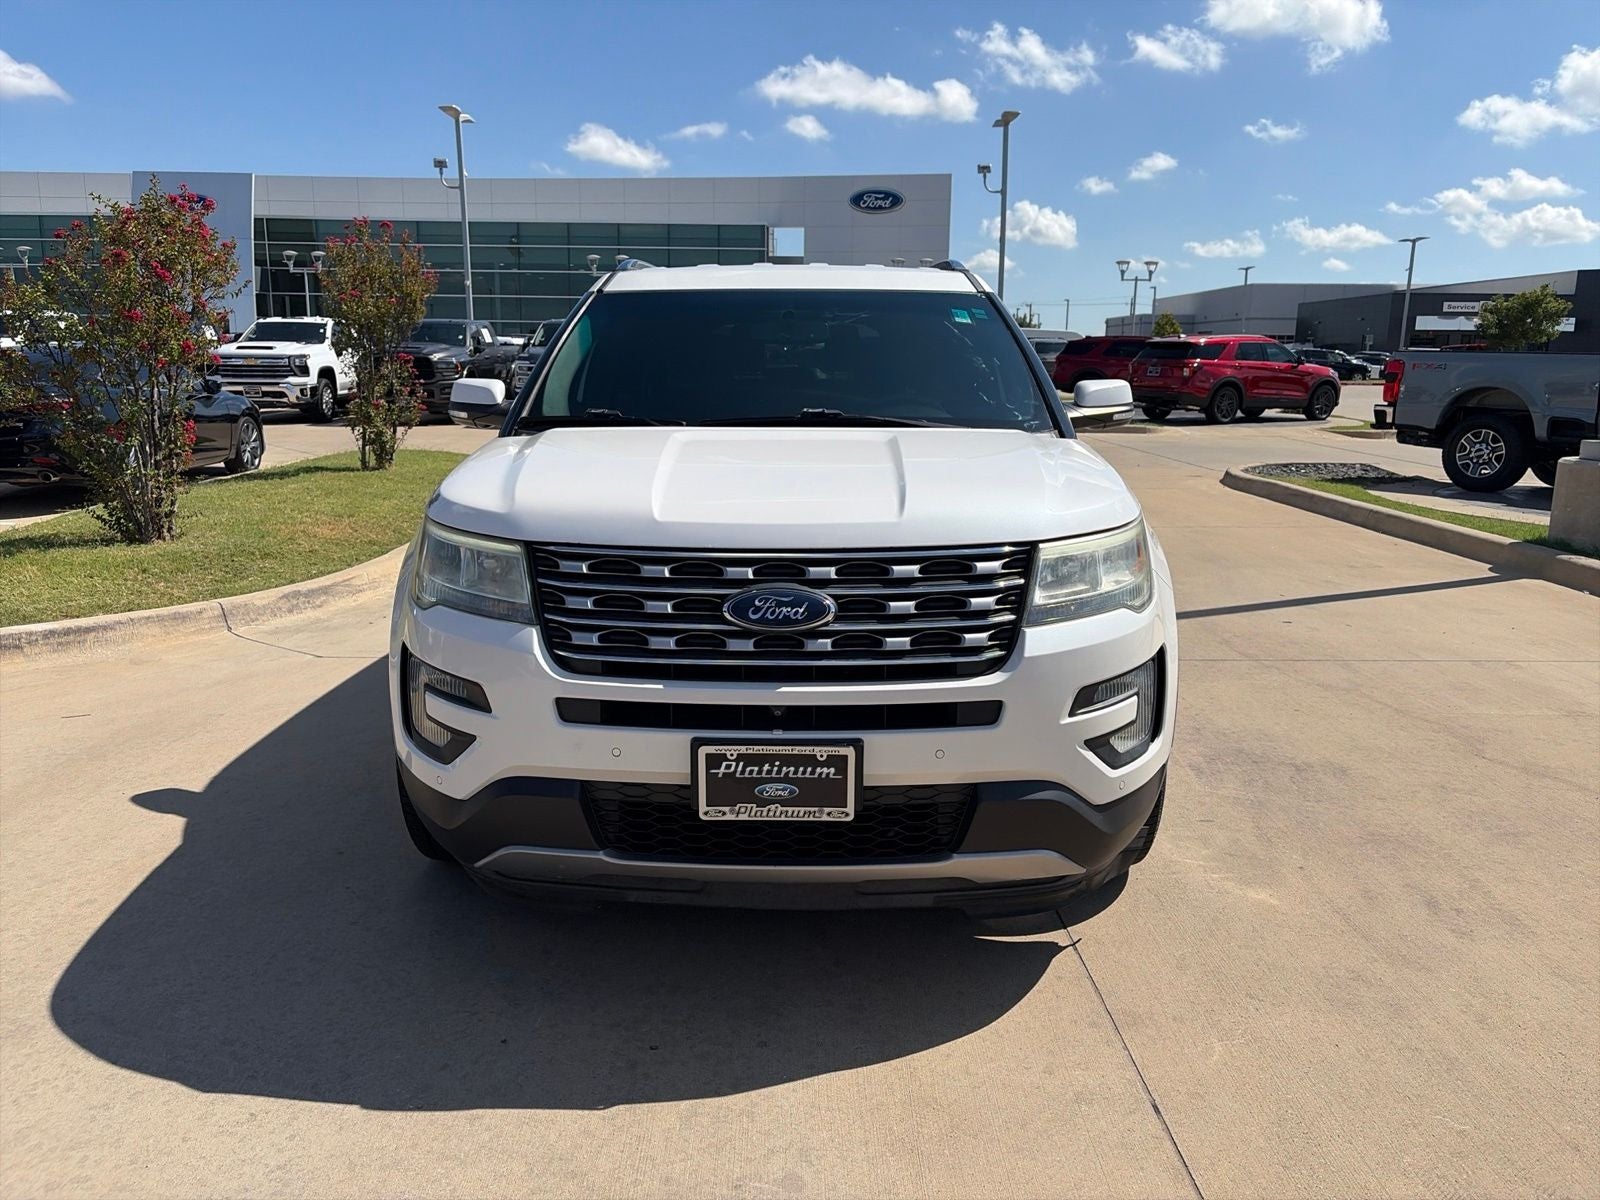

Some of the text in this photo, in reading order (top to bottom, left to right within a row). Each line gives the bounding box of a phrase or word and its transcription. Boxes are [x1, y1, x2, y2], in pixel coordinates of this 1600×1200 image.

[860, 193, 892, 207] Ford
[1412, 362, 1447, 370] FX4
[748, 595, 808, 619] Ford
[714, 746, 840, 754] www.PlatinumFord.com
[709, 761, 842, 778] Platinum
[763, 785, 790, 797] Ford
[735, 805, 823, 819] Platinum
